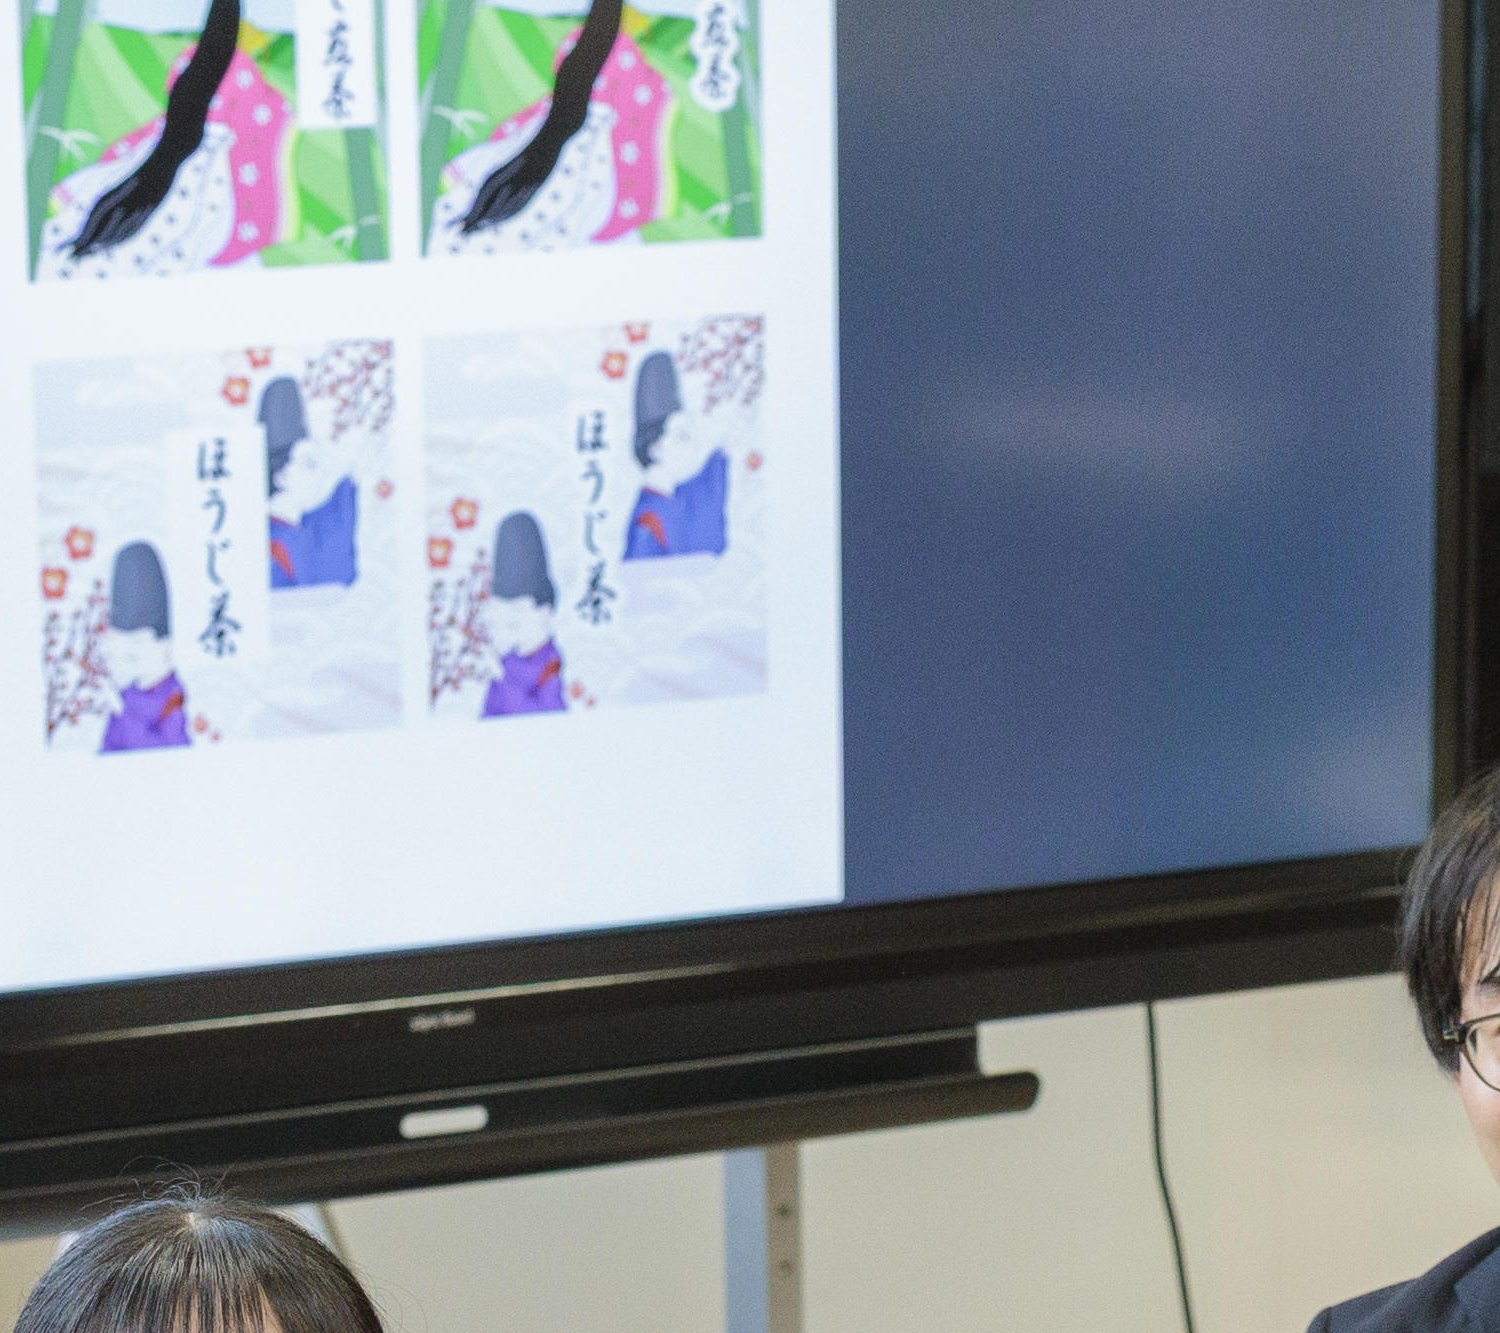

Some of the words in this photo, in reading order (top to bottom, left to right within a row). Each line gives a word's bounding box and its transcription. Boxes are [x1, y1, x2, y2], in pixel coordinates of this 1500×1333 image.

[197, 438, 242, 660] ほうじ茶
[577, 411, 619, 628] ほうじ茶
